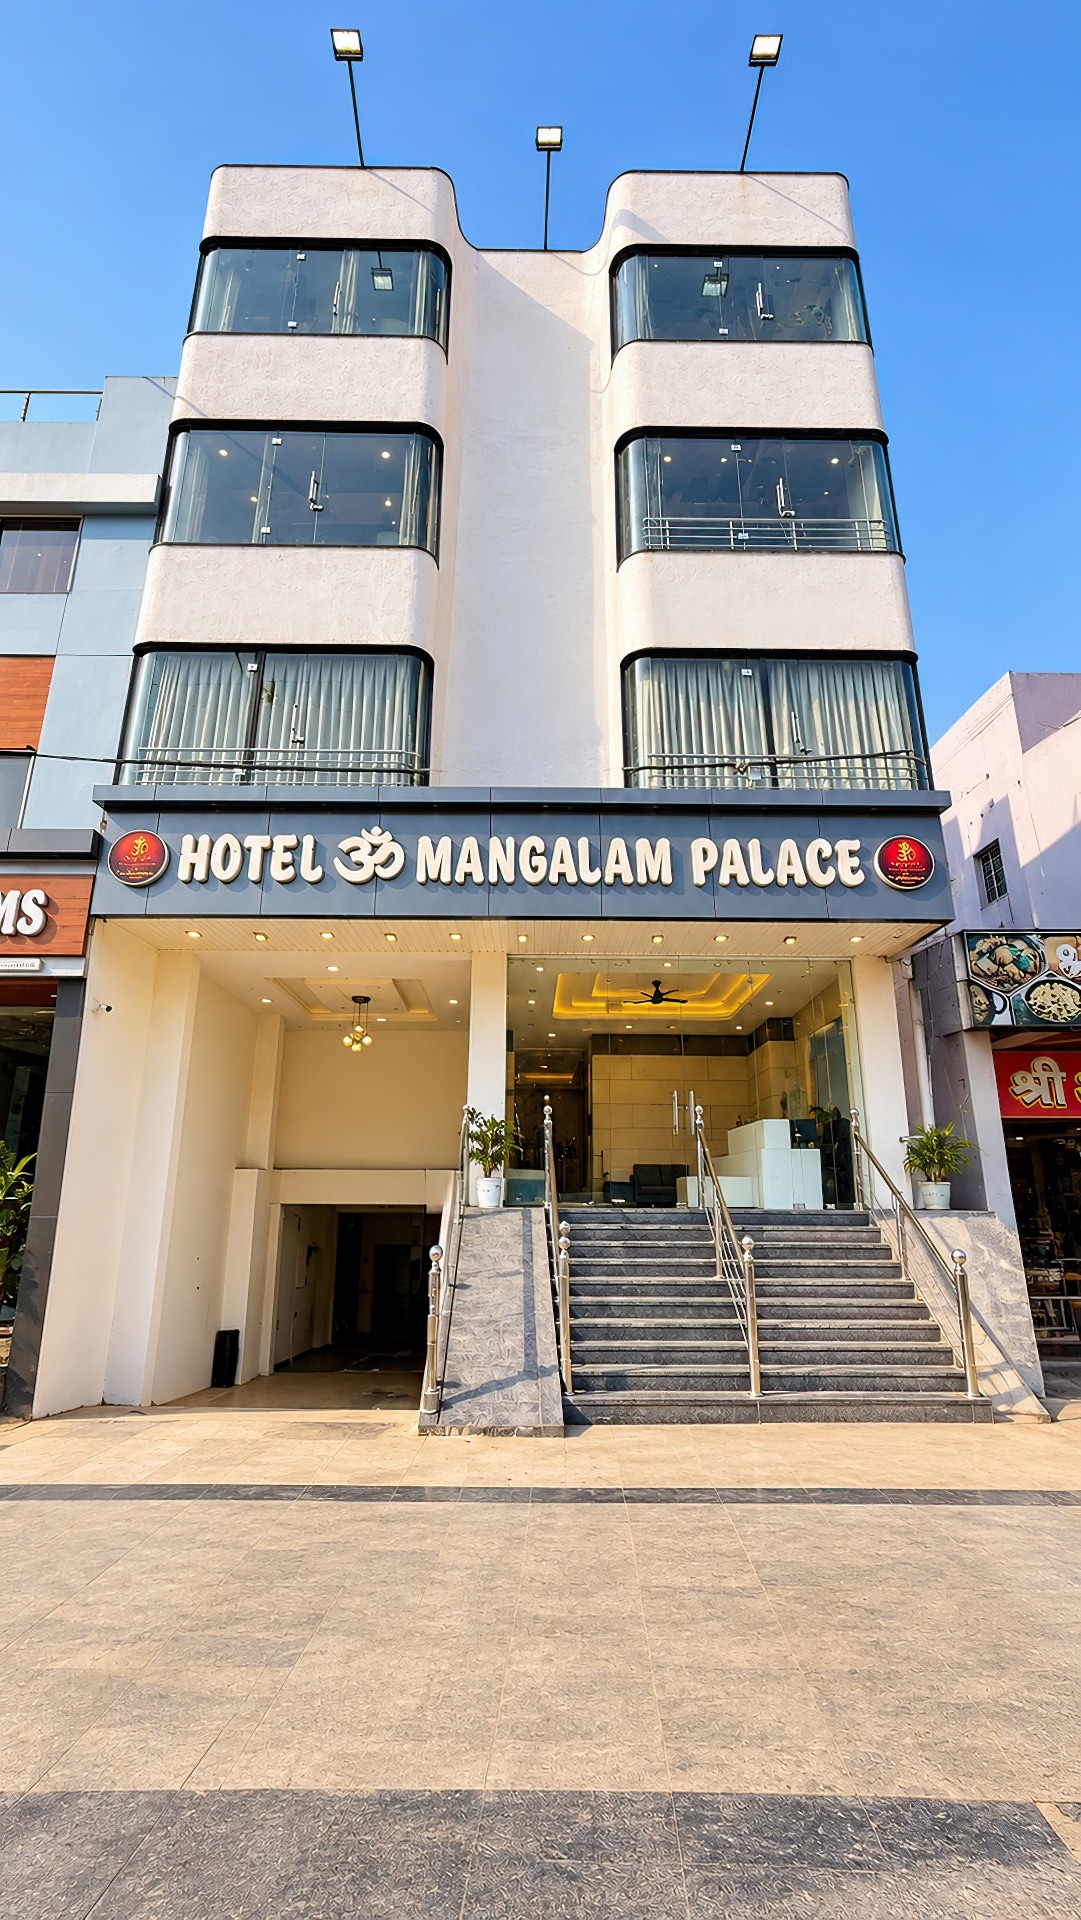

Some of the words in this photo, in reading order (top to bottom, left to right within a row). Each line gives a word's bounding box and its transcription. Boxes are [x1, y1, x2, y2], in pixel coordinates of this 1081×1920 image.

[177, 833, 324, 883] HOTEL
[416, 835, 673, 887] MANGALAM
[690, 838, 866, 888] PALACE
[1009, 1056, 1067, 1109] श्री
